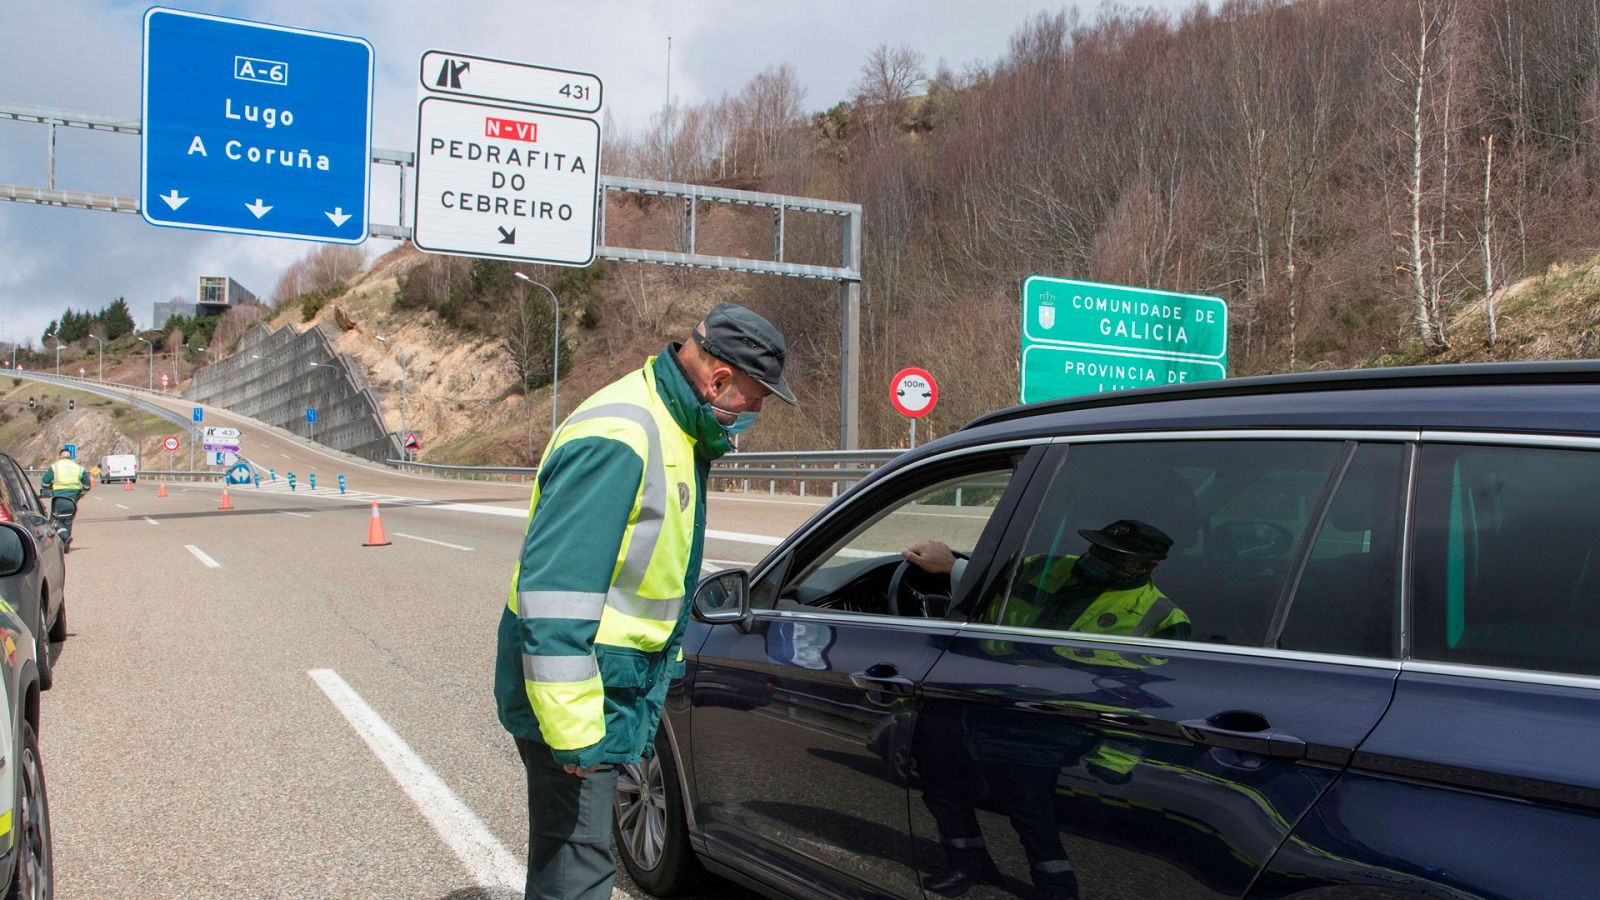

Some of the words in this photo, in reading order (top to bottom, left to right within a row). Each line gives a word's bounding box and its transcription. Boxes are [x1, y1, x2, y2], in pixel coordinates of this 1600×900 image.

[240, 60, 283, 81] A-6
[559, 83, 590, 101] 431
[225, 98, 294, 128] Lugo
[487, 119, 535, 141] N-VI
[187, 135, 208, 157] A
[225, 140, 330, 170] Coruña
[431, 138, 586, 174] PEDRAFITA
[492, 171, 526, 191] DO
[441, 190, 573, 221] CEBREIRO
[1072, 295, 1182, 320] COMUNIDADE
[1195, 309, 1215, 324] DE
[1099, 318, 1188, 343] GALICIA
[903, 380, 925, 388] 100m
[1065, 360, 1156, 381] PROVINCIA
[1167, 370, 1188, 384] DE
